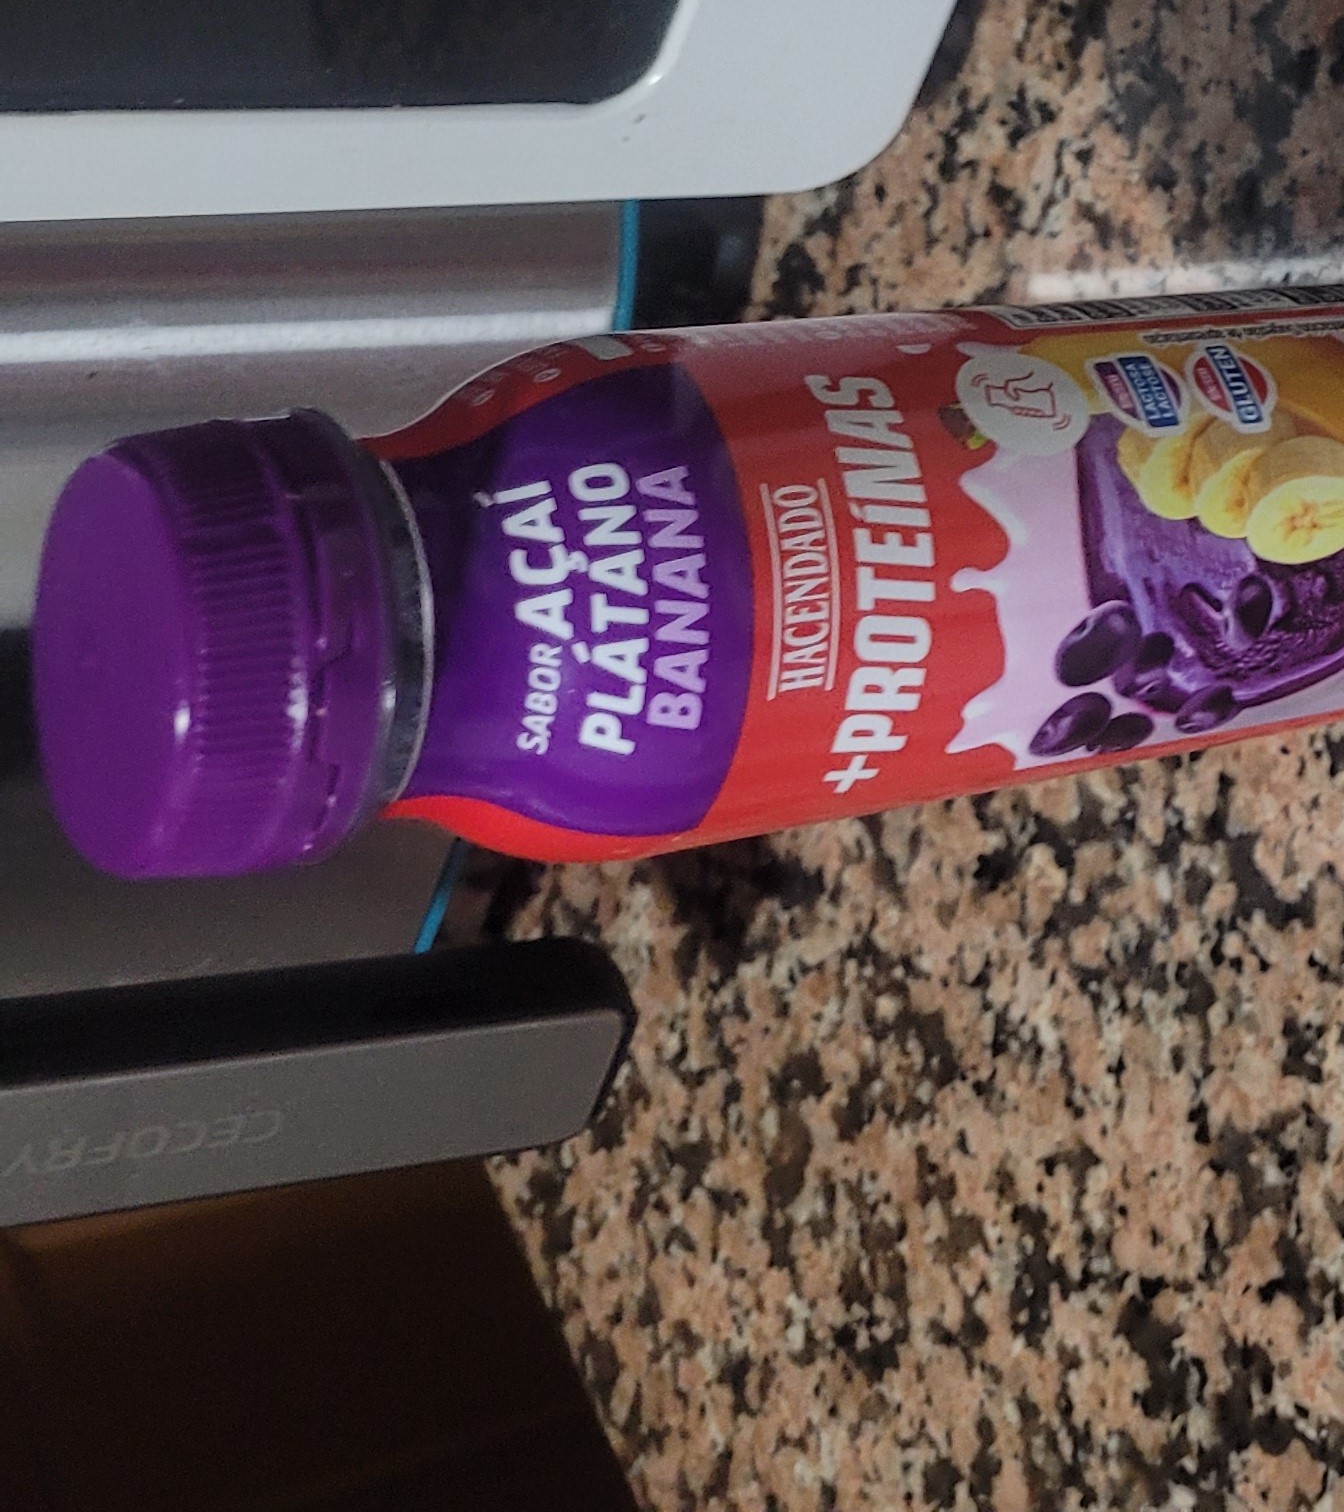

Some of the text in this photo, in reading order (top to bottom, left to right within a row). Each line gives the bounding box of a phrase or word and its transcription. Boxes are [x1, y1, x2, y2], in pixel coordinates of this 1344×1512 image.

[1127, 363, 1161, 420] LACTOSA
[1140, 362, 1174, 419] LACTOSE
[1209, 346, 1260, 421] GLUTEN
[475, 479, 589, 640] AÇAÍ
[568, 462, 650, 755] PLÁTANO
[636, 465, 710, 730] BANANA
[773, 484, 830, 691] HACENDADO
[516, 643, 562, 755] SABOR
